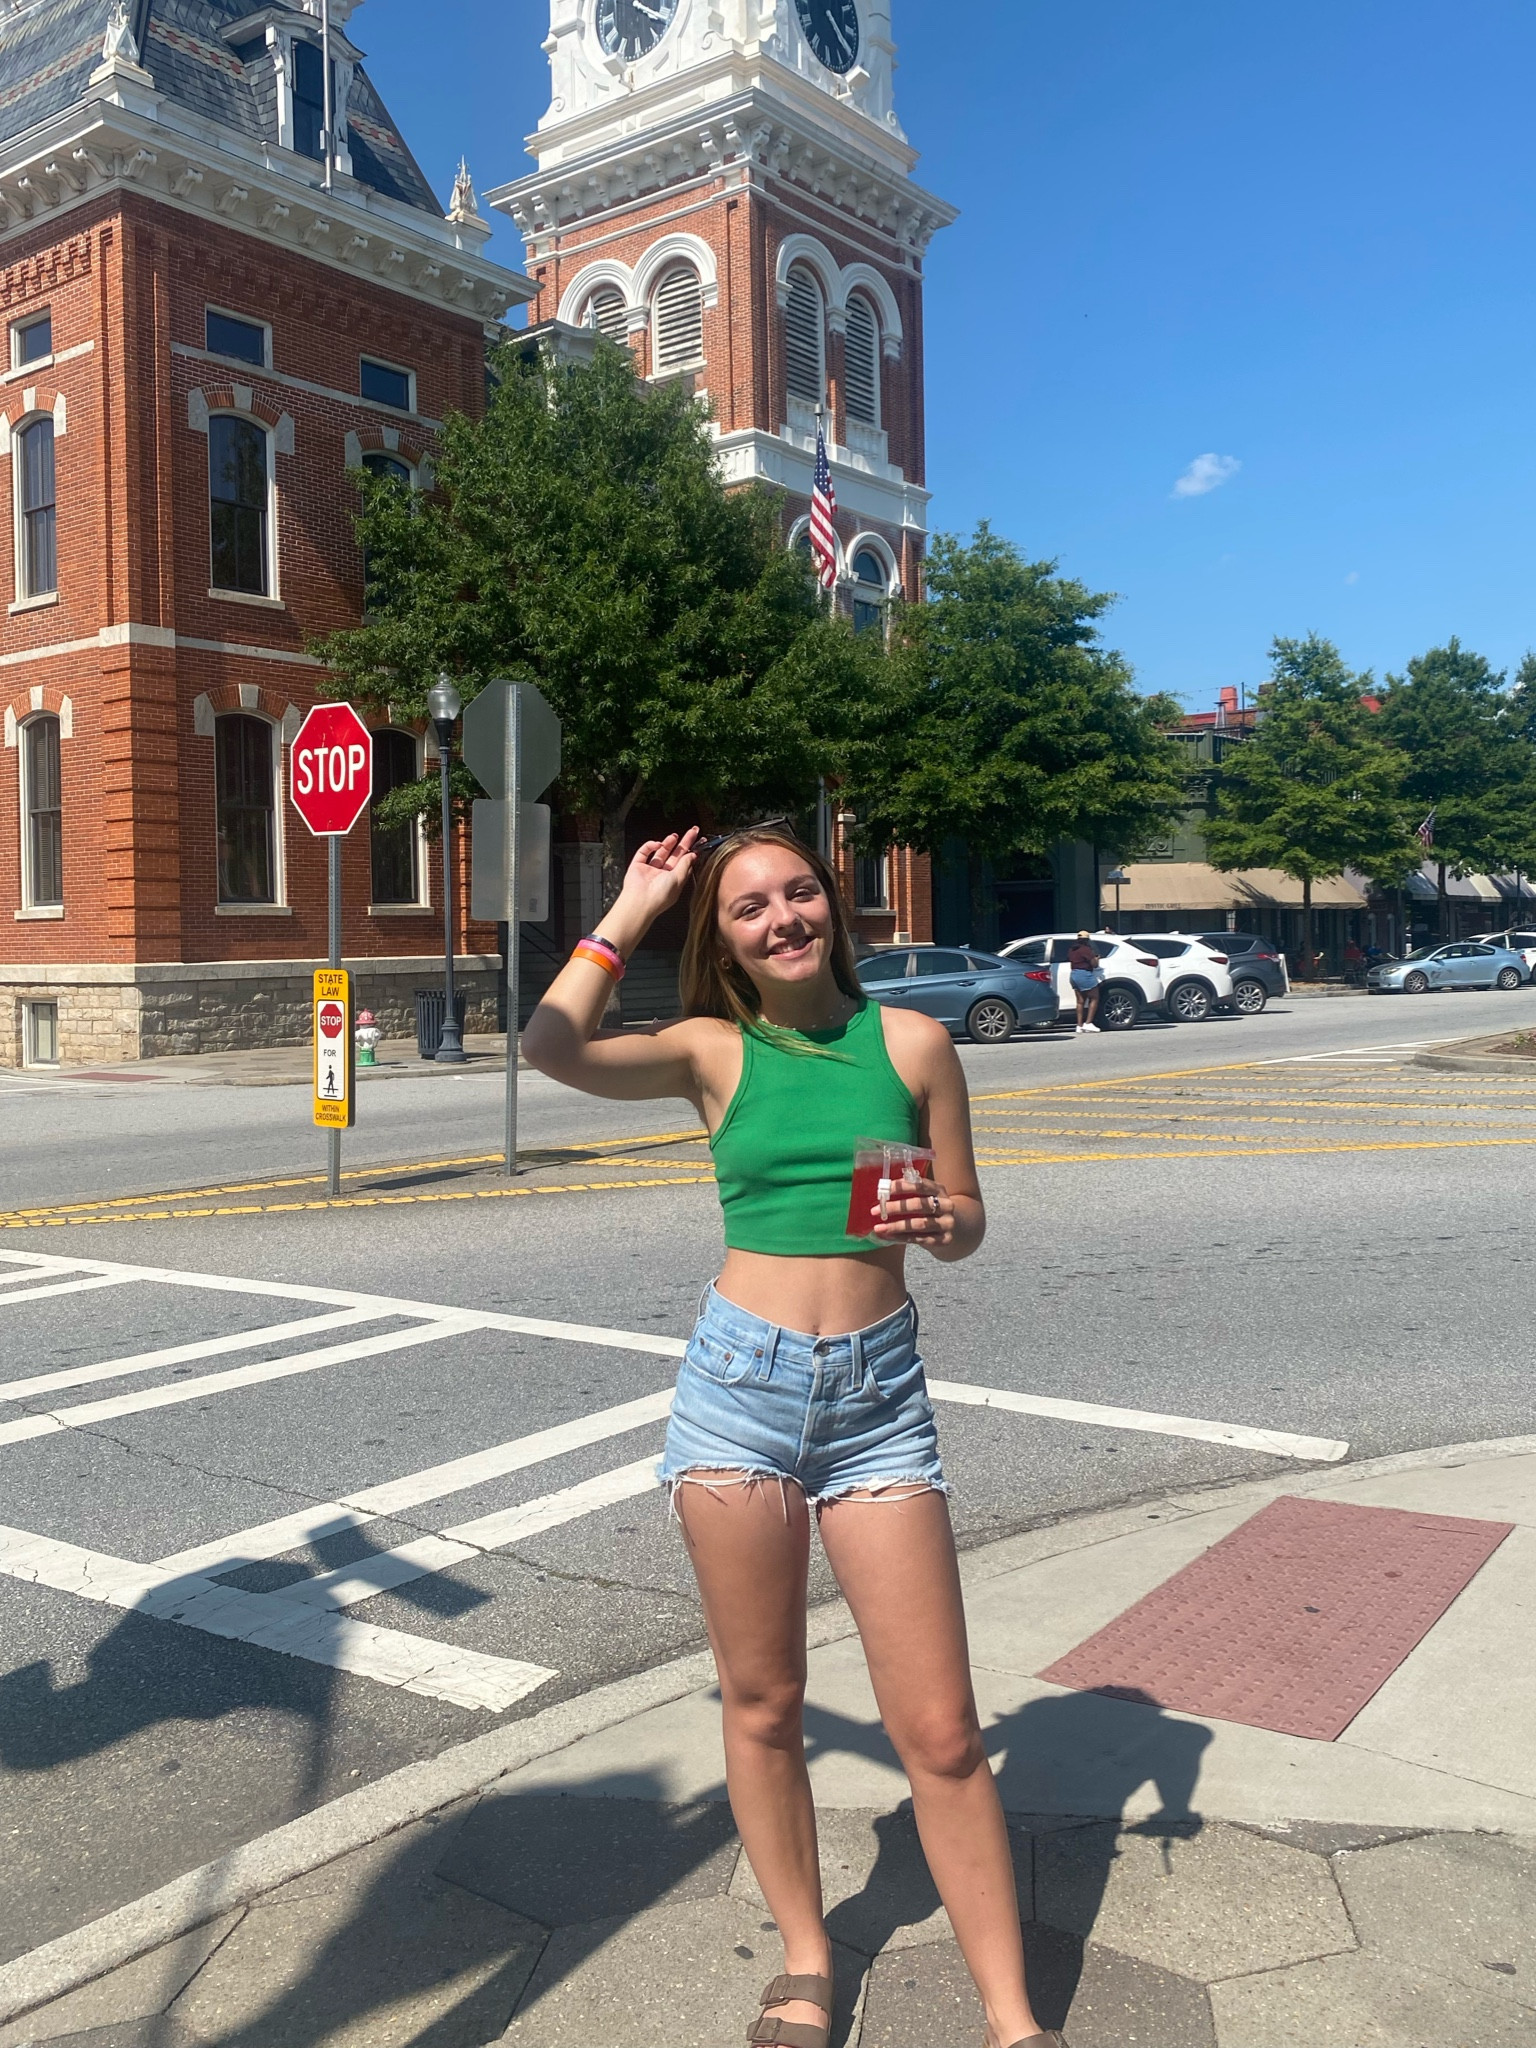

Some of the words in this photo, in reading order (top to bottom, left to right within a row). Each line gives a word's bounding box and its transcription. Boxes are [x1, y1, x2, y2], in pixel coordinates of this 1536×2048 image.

[298, 744, 366, 795] STOP
[318, 973, 343, 984] STATE
[321, 986, 340, 996] LAW
[320, 1015, 342, 1026] STOP
[323, 1049, 337, 1057] FOR
[321, 1104, 340, 1113] WITHIN
[315, 1112, 347, 1122] CROSSWALK
